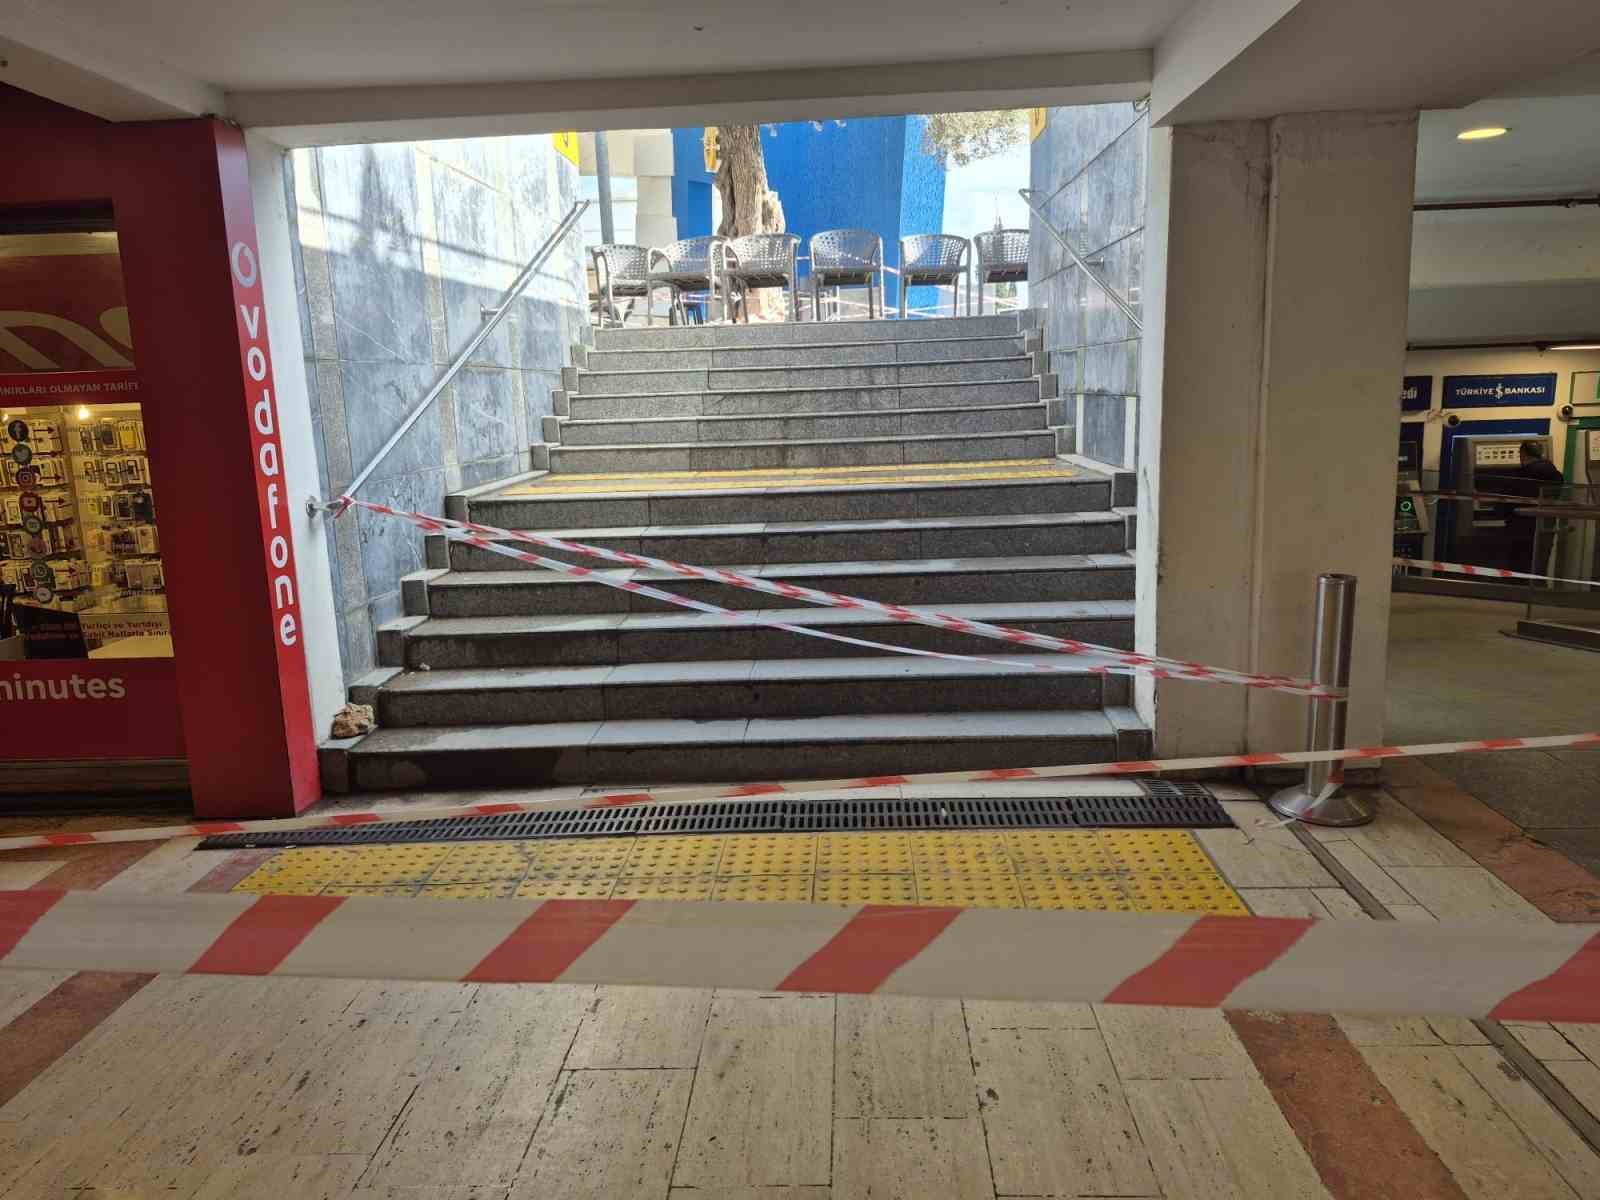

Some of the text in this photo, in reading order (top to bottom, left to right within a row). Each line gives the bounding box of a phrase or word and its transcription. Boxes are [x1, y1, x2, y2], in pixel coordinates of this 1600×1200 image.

[240, 303, 297, 646] vodafone
[1456, 387, 1495, 396] TÜRKİYE
[1504, 386, 1545, 395] BANKASI
